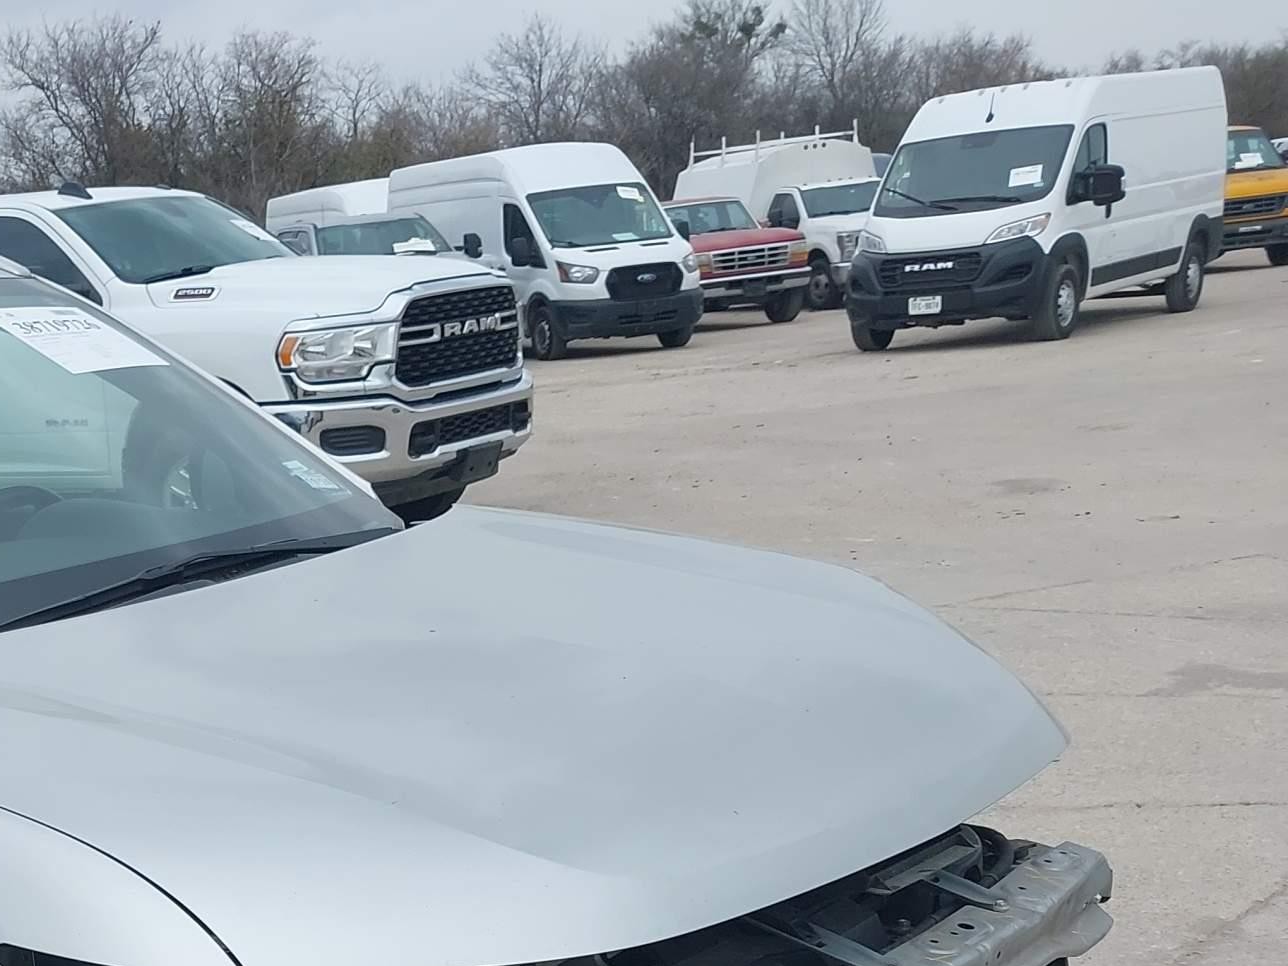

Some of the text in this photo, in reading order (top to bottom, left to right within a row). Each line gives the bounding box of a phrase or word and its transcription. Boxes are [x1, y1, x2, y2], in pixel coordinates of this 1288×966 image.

[904, 261, 954, 273] RAM
[12, 318, 101, 335] 38719726
[443, 316, 497, 338] RAM
